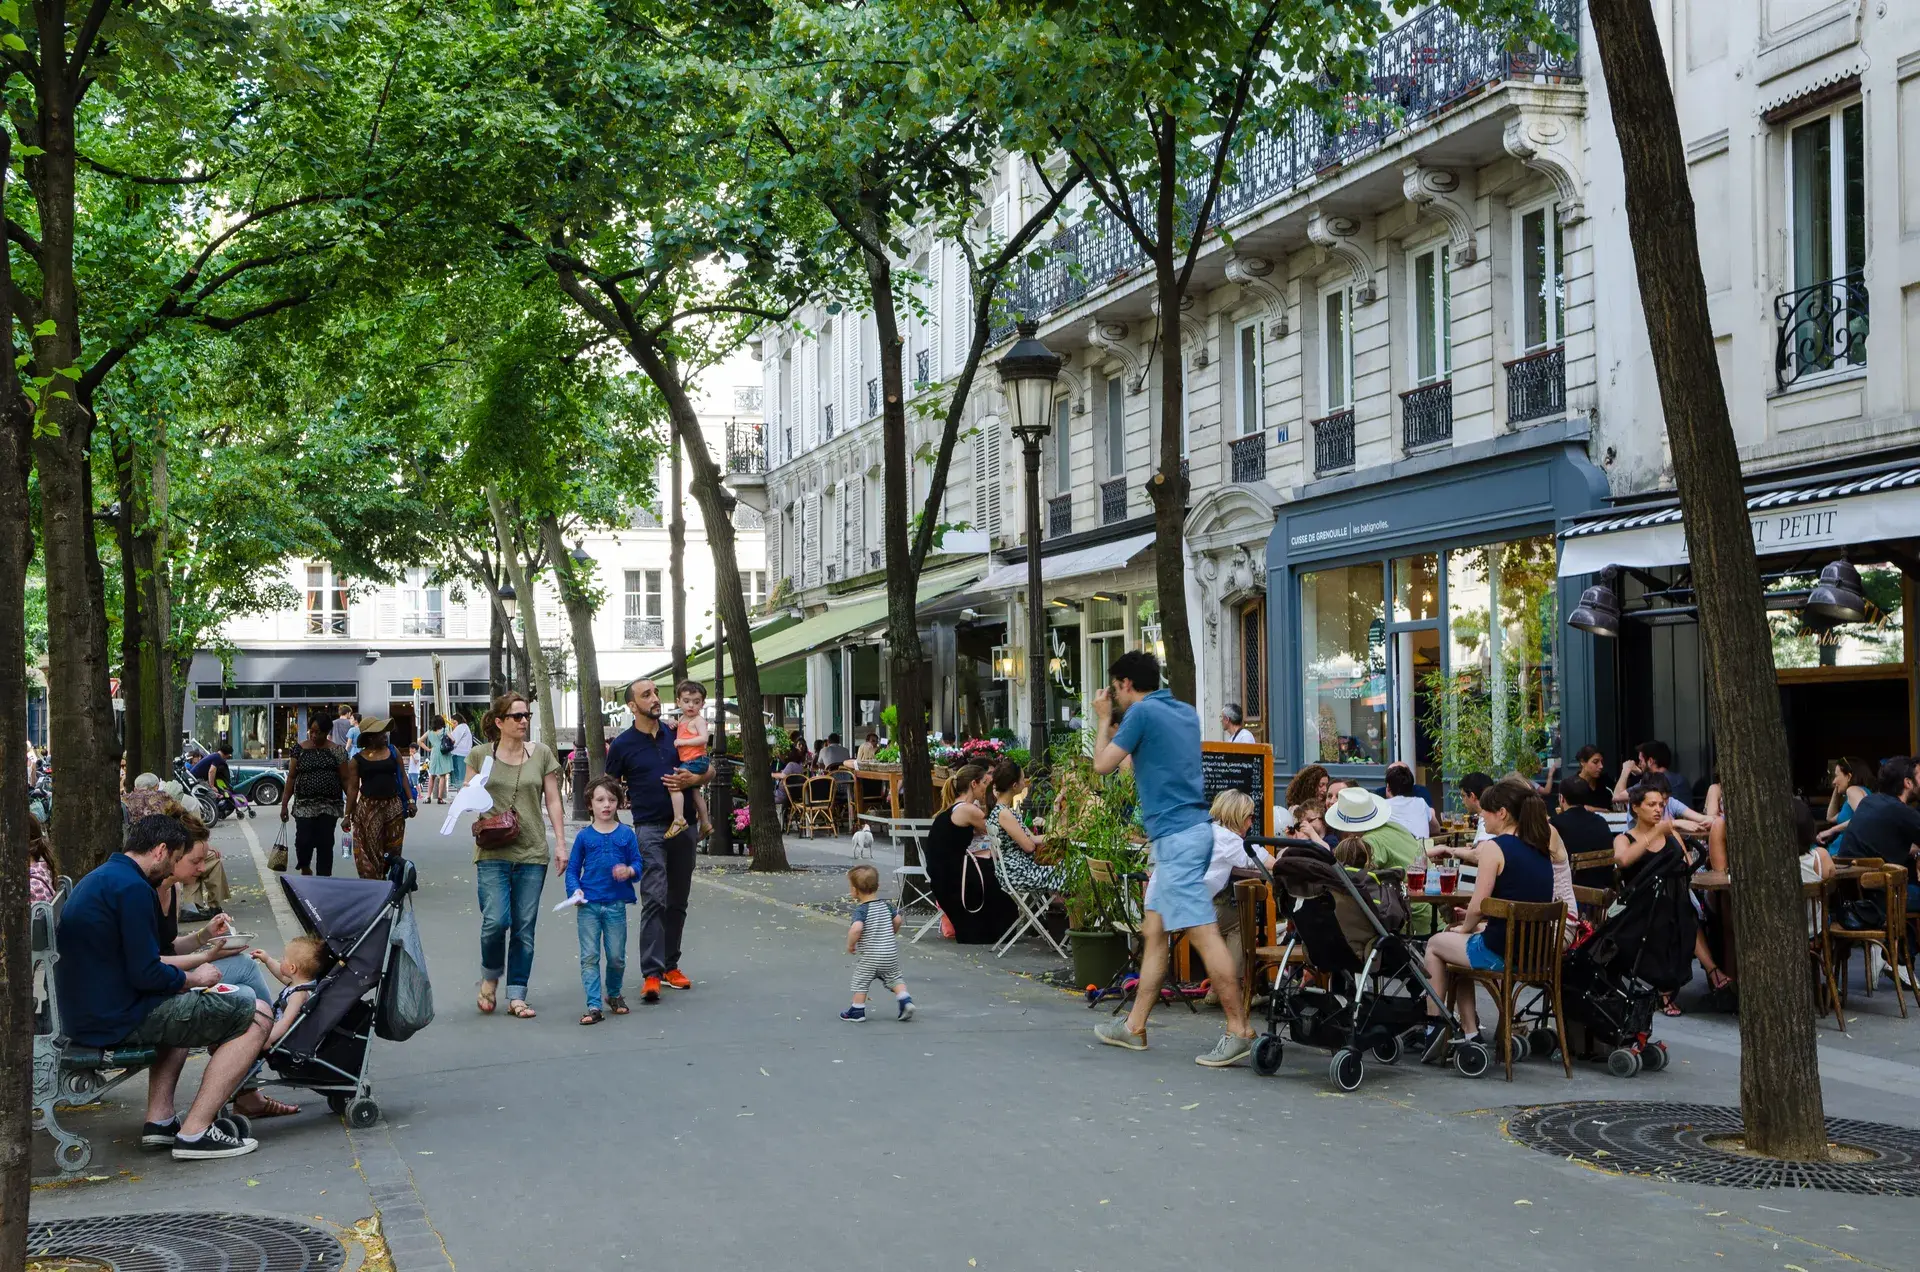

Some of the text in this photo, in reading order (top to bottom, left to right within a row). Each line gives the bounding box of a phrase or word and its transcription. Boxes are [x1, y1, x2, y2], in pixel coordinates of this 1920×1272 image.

[1778, 511, 1837, 540] PETIT
[1291, 534, 1308, 546] CUISSE
[1308, 532, 1316, 543] DE
[1316, 527, 1348, 541] GRENOUILLE
[1333, 688, 1358, 699] SOLDES
